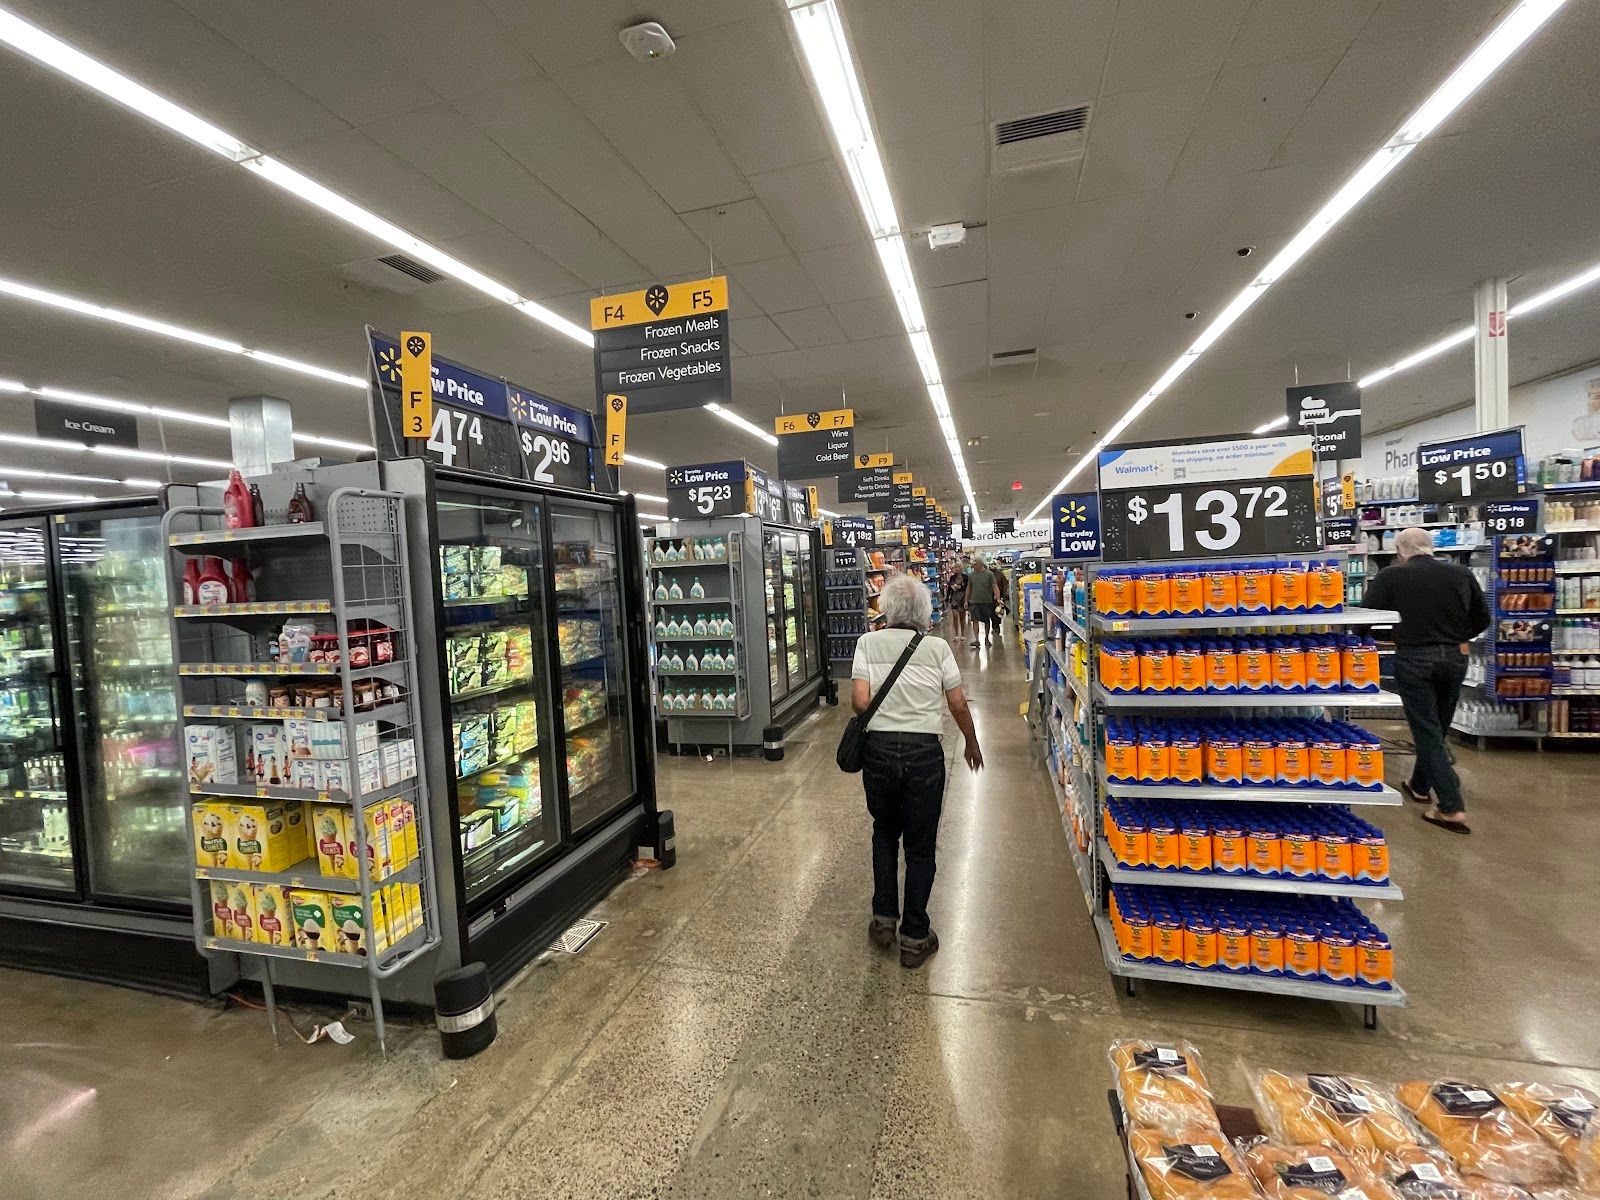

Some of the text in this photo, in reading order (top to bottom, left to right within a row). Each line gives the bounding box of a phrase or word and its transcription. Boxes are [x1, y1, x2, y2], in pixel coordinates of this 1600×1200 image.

[692, 290, 713, 309] F5
[604, 305, 625, 323] F4
[645, 316, 719, 340] Frozen Meals
[640, 338, 720, 361] Frozen Snacks
[618, 360, 721, 384] Frozen Vegetables
[447, 378, 484, 406] Price
[410, 392, 422, 408] F
[64, 419, 115, 434] Ice Cream
[412, 416, 422, 432] 3
[530, 406, 577, 434] Low Price
[784, 422, 795, 431] F6
[834, 416, 845, 425] F7
[612, 434, 620, 446] F
[1312, 431, 1346, 442] ersonal
[827, 442, 848, 450] Liquor
[1312, 444, 1336, 452] Care
[612, 451, 620, 462] 4
[816, 454, 832, 462] Cold
[1385, 449, 1416, 470] Phar
[1422, 446, 1491, 466] Low Price
[685, 470, 729, 483] Low Price
[970, 529, 1049, 540] Garden Center
[1061, 538, 1096, 552] Low
